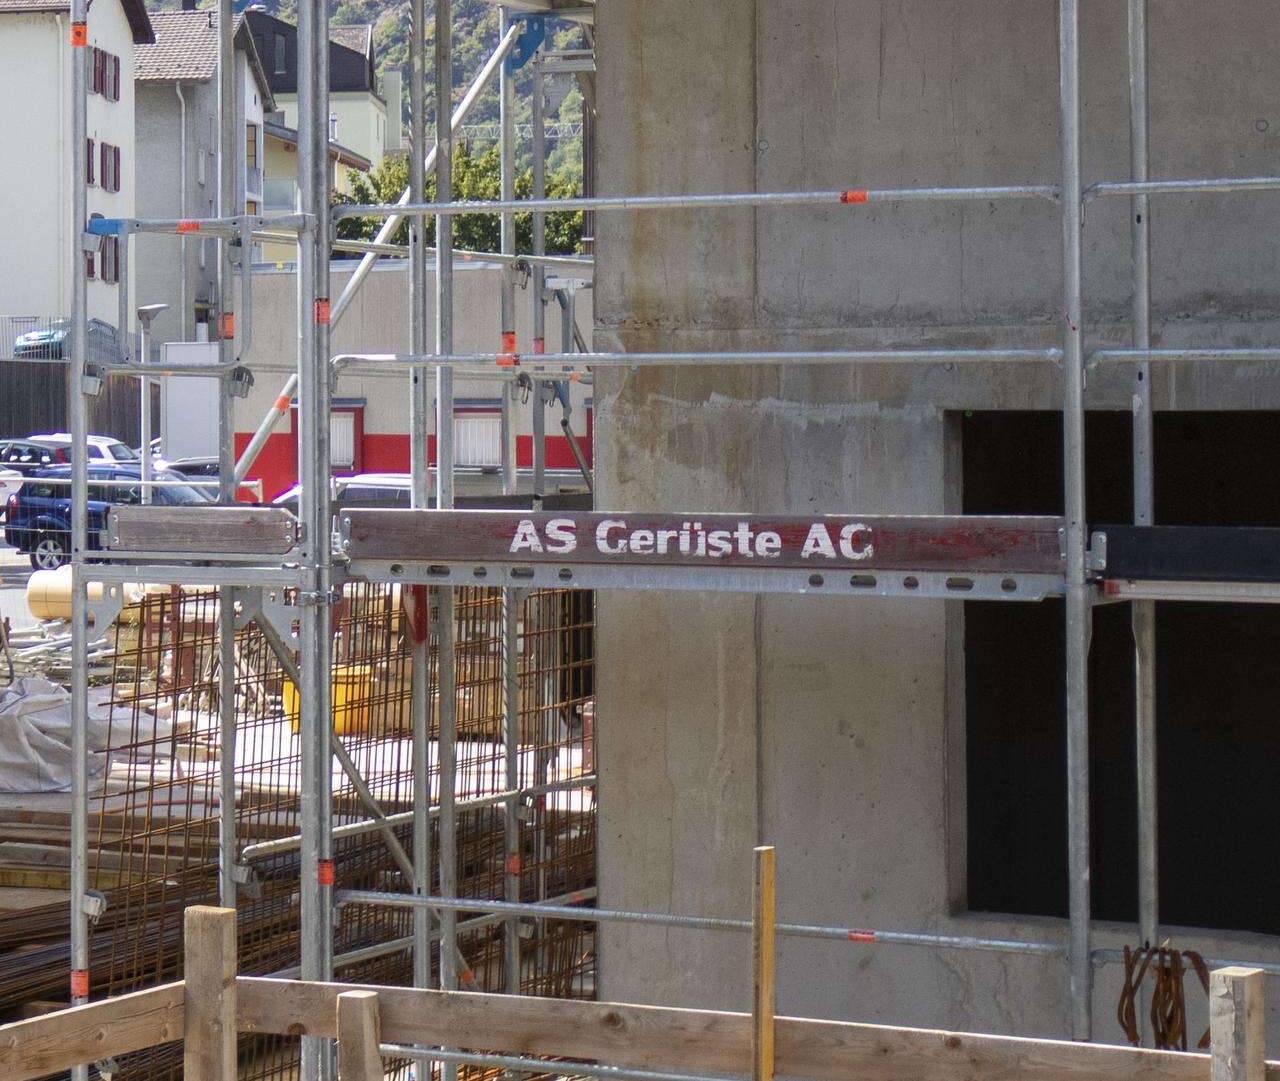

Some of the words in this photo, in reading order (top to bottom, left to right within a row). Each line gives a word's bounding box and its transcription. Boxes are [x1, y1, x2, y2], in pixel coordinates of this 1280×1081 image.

[509, 519, 578, 555] AS
[596, 520, 782, 558] Gerüste
[800, 522, 873, 560] AG
